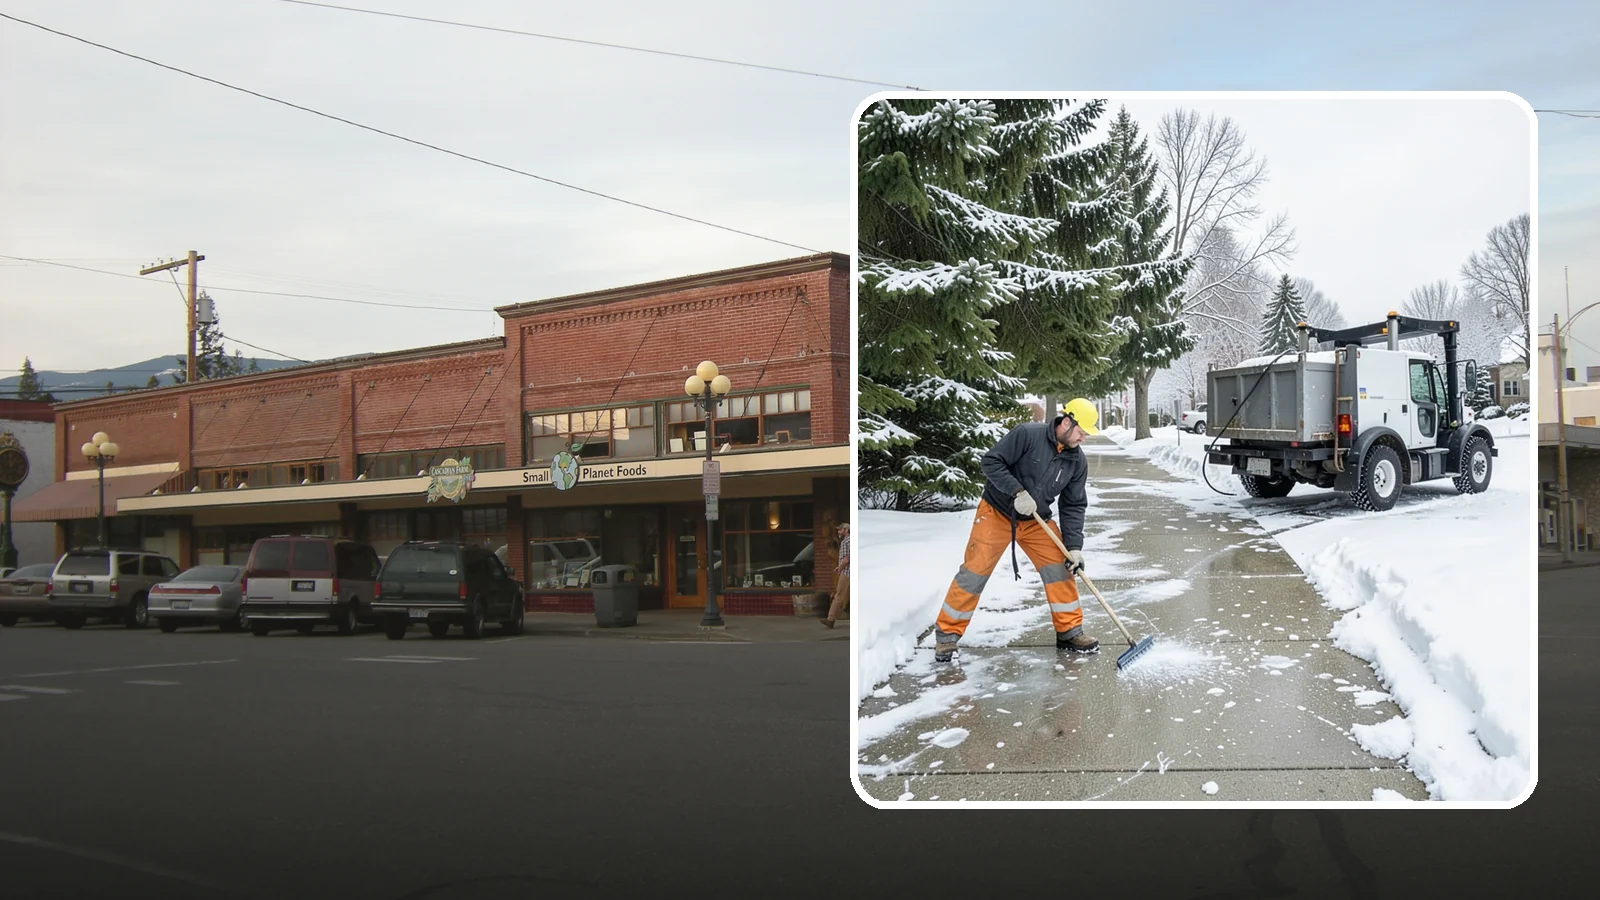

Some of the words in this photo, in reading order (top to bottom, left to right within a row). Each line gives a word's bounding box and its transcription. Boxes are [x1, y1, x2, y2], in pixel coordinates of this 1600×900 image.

[431, 467, 456, 476] CASCADIAN
[523, 471, 549, 483] Small
[583, 467, 614, 479] Planet
[617, 464, 647, 477] Foods
